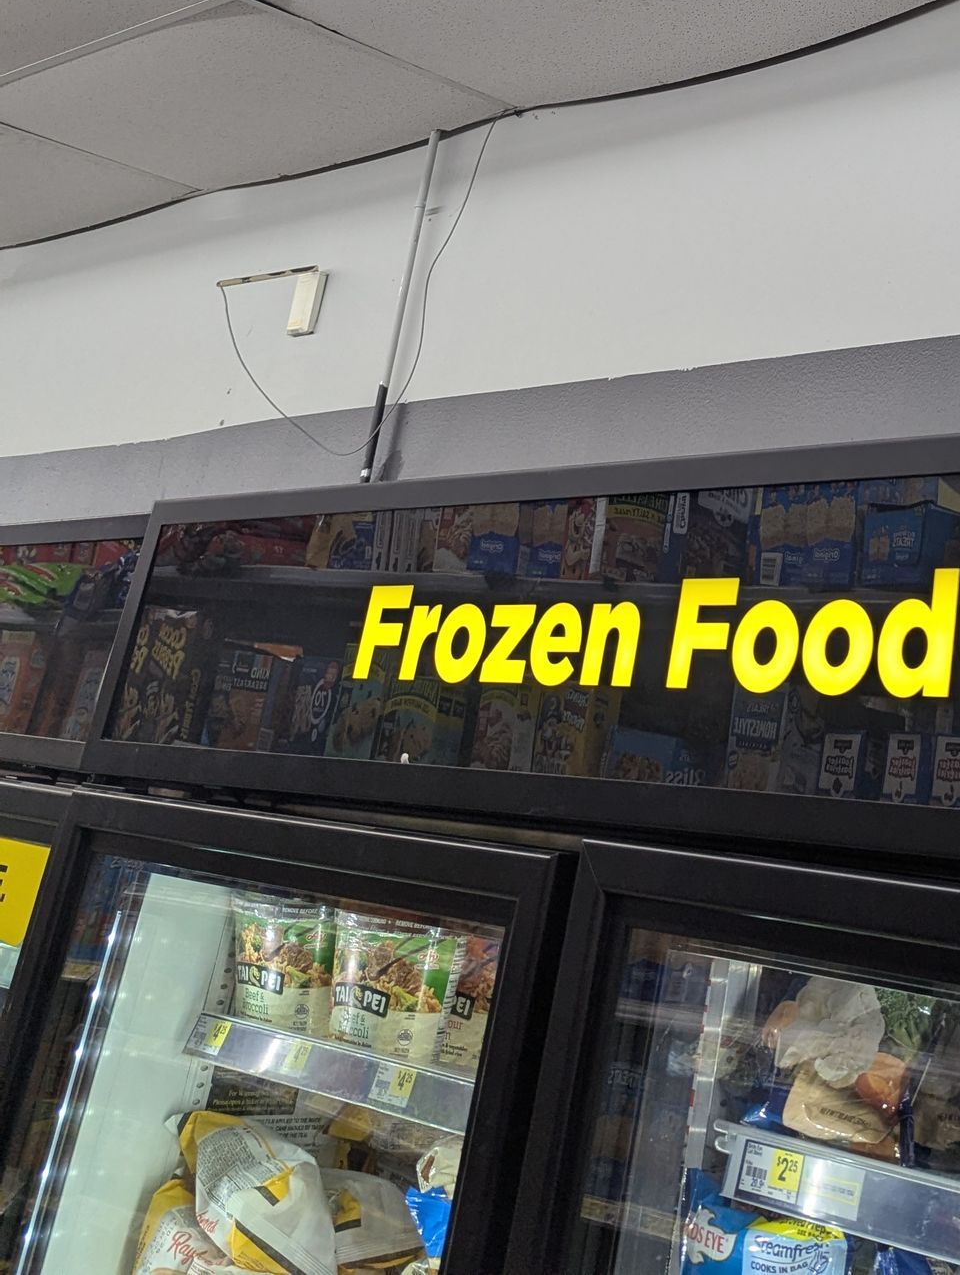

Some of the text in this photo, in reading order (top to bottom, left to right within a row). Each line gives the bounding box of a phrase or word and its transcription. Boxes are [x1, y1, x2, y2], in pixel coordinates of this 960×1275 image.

[352, 567, 960, 699] Frozen Food
[237, 964, 282, 992] TAI PEI
[335, 984, 386, 1013] TAI PEI
[704, 1231, 724, 1253] EYE
[750, 1261, 777, 1274] COOKS
[778, 1266, 789, 1274] IN
